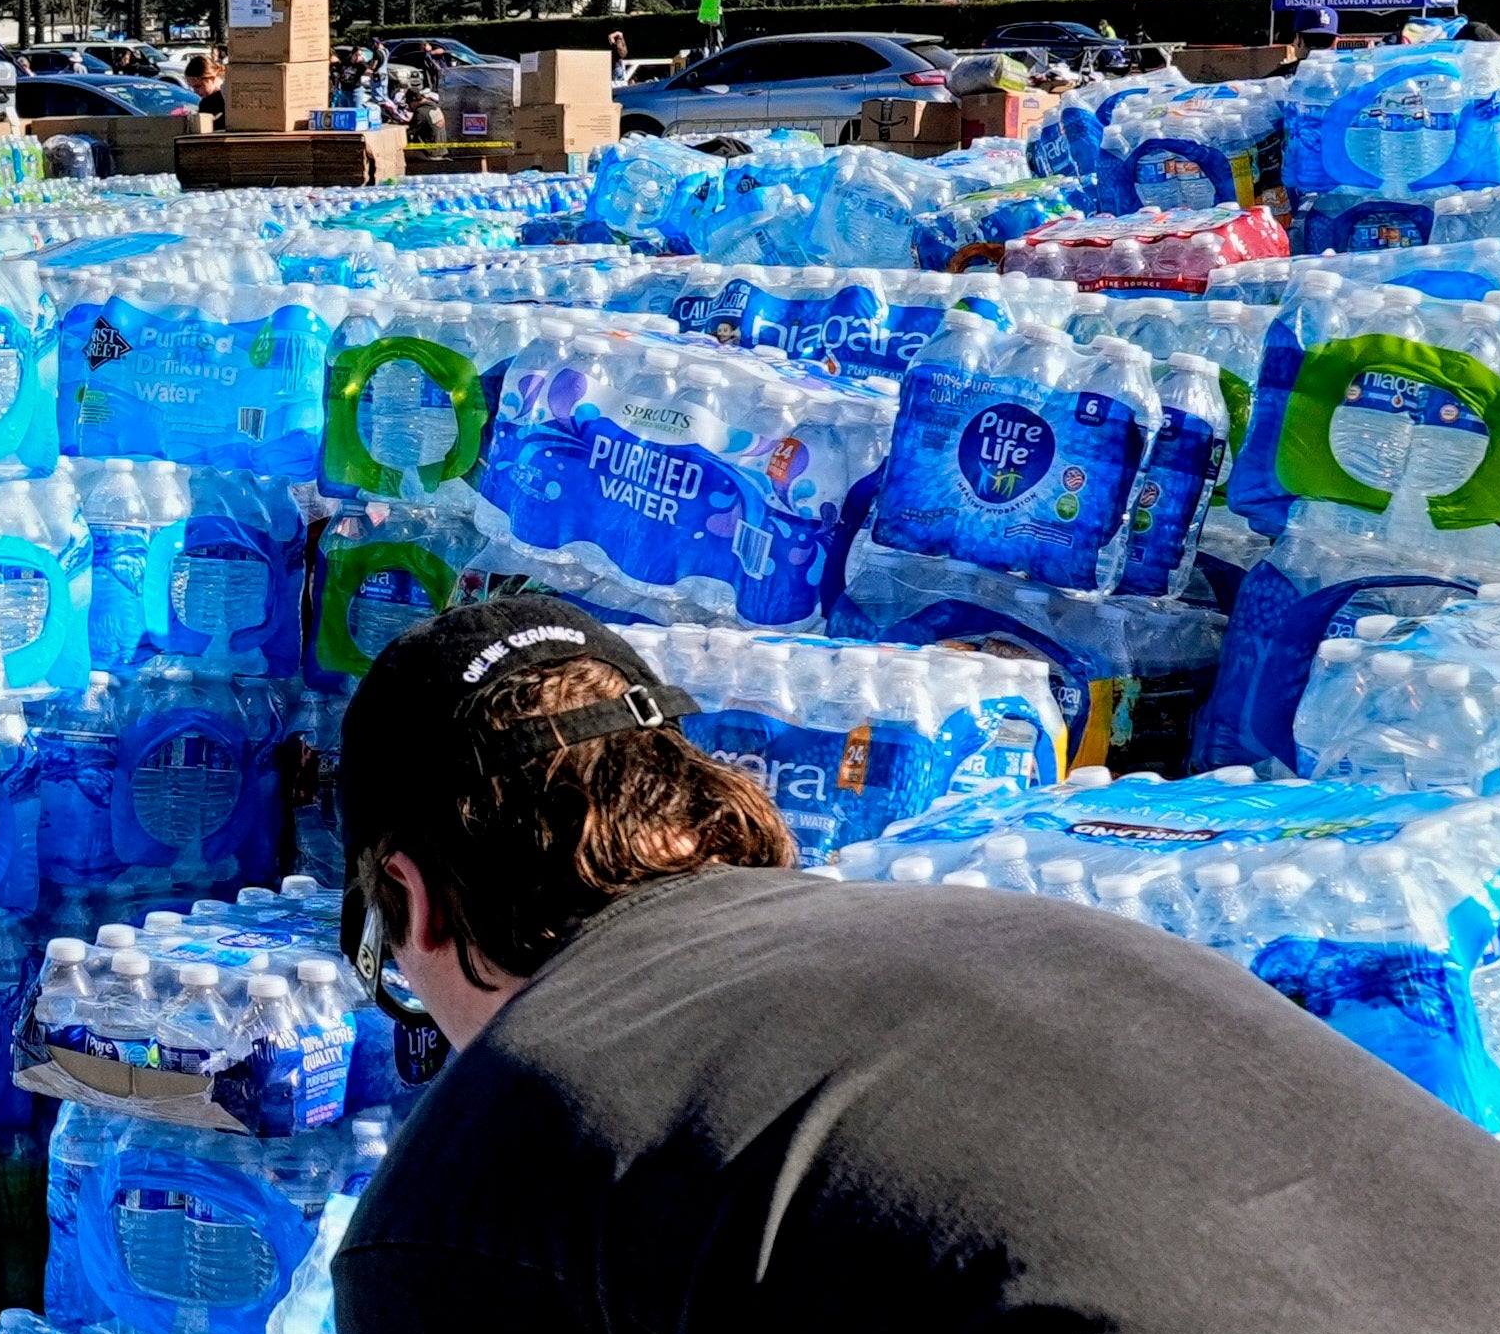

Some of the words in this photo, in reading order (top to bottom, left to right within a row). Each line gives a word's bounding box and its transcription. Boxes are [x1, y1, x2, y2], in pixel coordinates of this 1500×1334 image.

[140, 326, 235, 354] Purified
[134, 380, 201, 403] Water
[929, 388, 977, 408] QUALITY
[964, 378, 997, 395] PURE
[622, 403, 693, 429] SPROUTS
[1085, 399, 1099, 415] 6
[978, 411, 1044, 442] Pure
[980, 437, 1029, 468] Life
[588, 435, 702, 500] PURIFIED
[599, 475, 679, 525] WATER
[985, 491, 1039, 516] HYDRATION
[463, 640, 510, 683] ONLINE
[508, 626, 586, 648] CERAMICS
[847, 744, 865, 766] 24
[89, 1037, 114, 1058] Pure
[408, 1025, 437, 1056] Life
[302, 1047, 344, 1070] QUALITY
